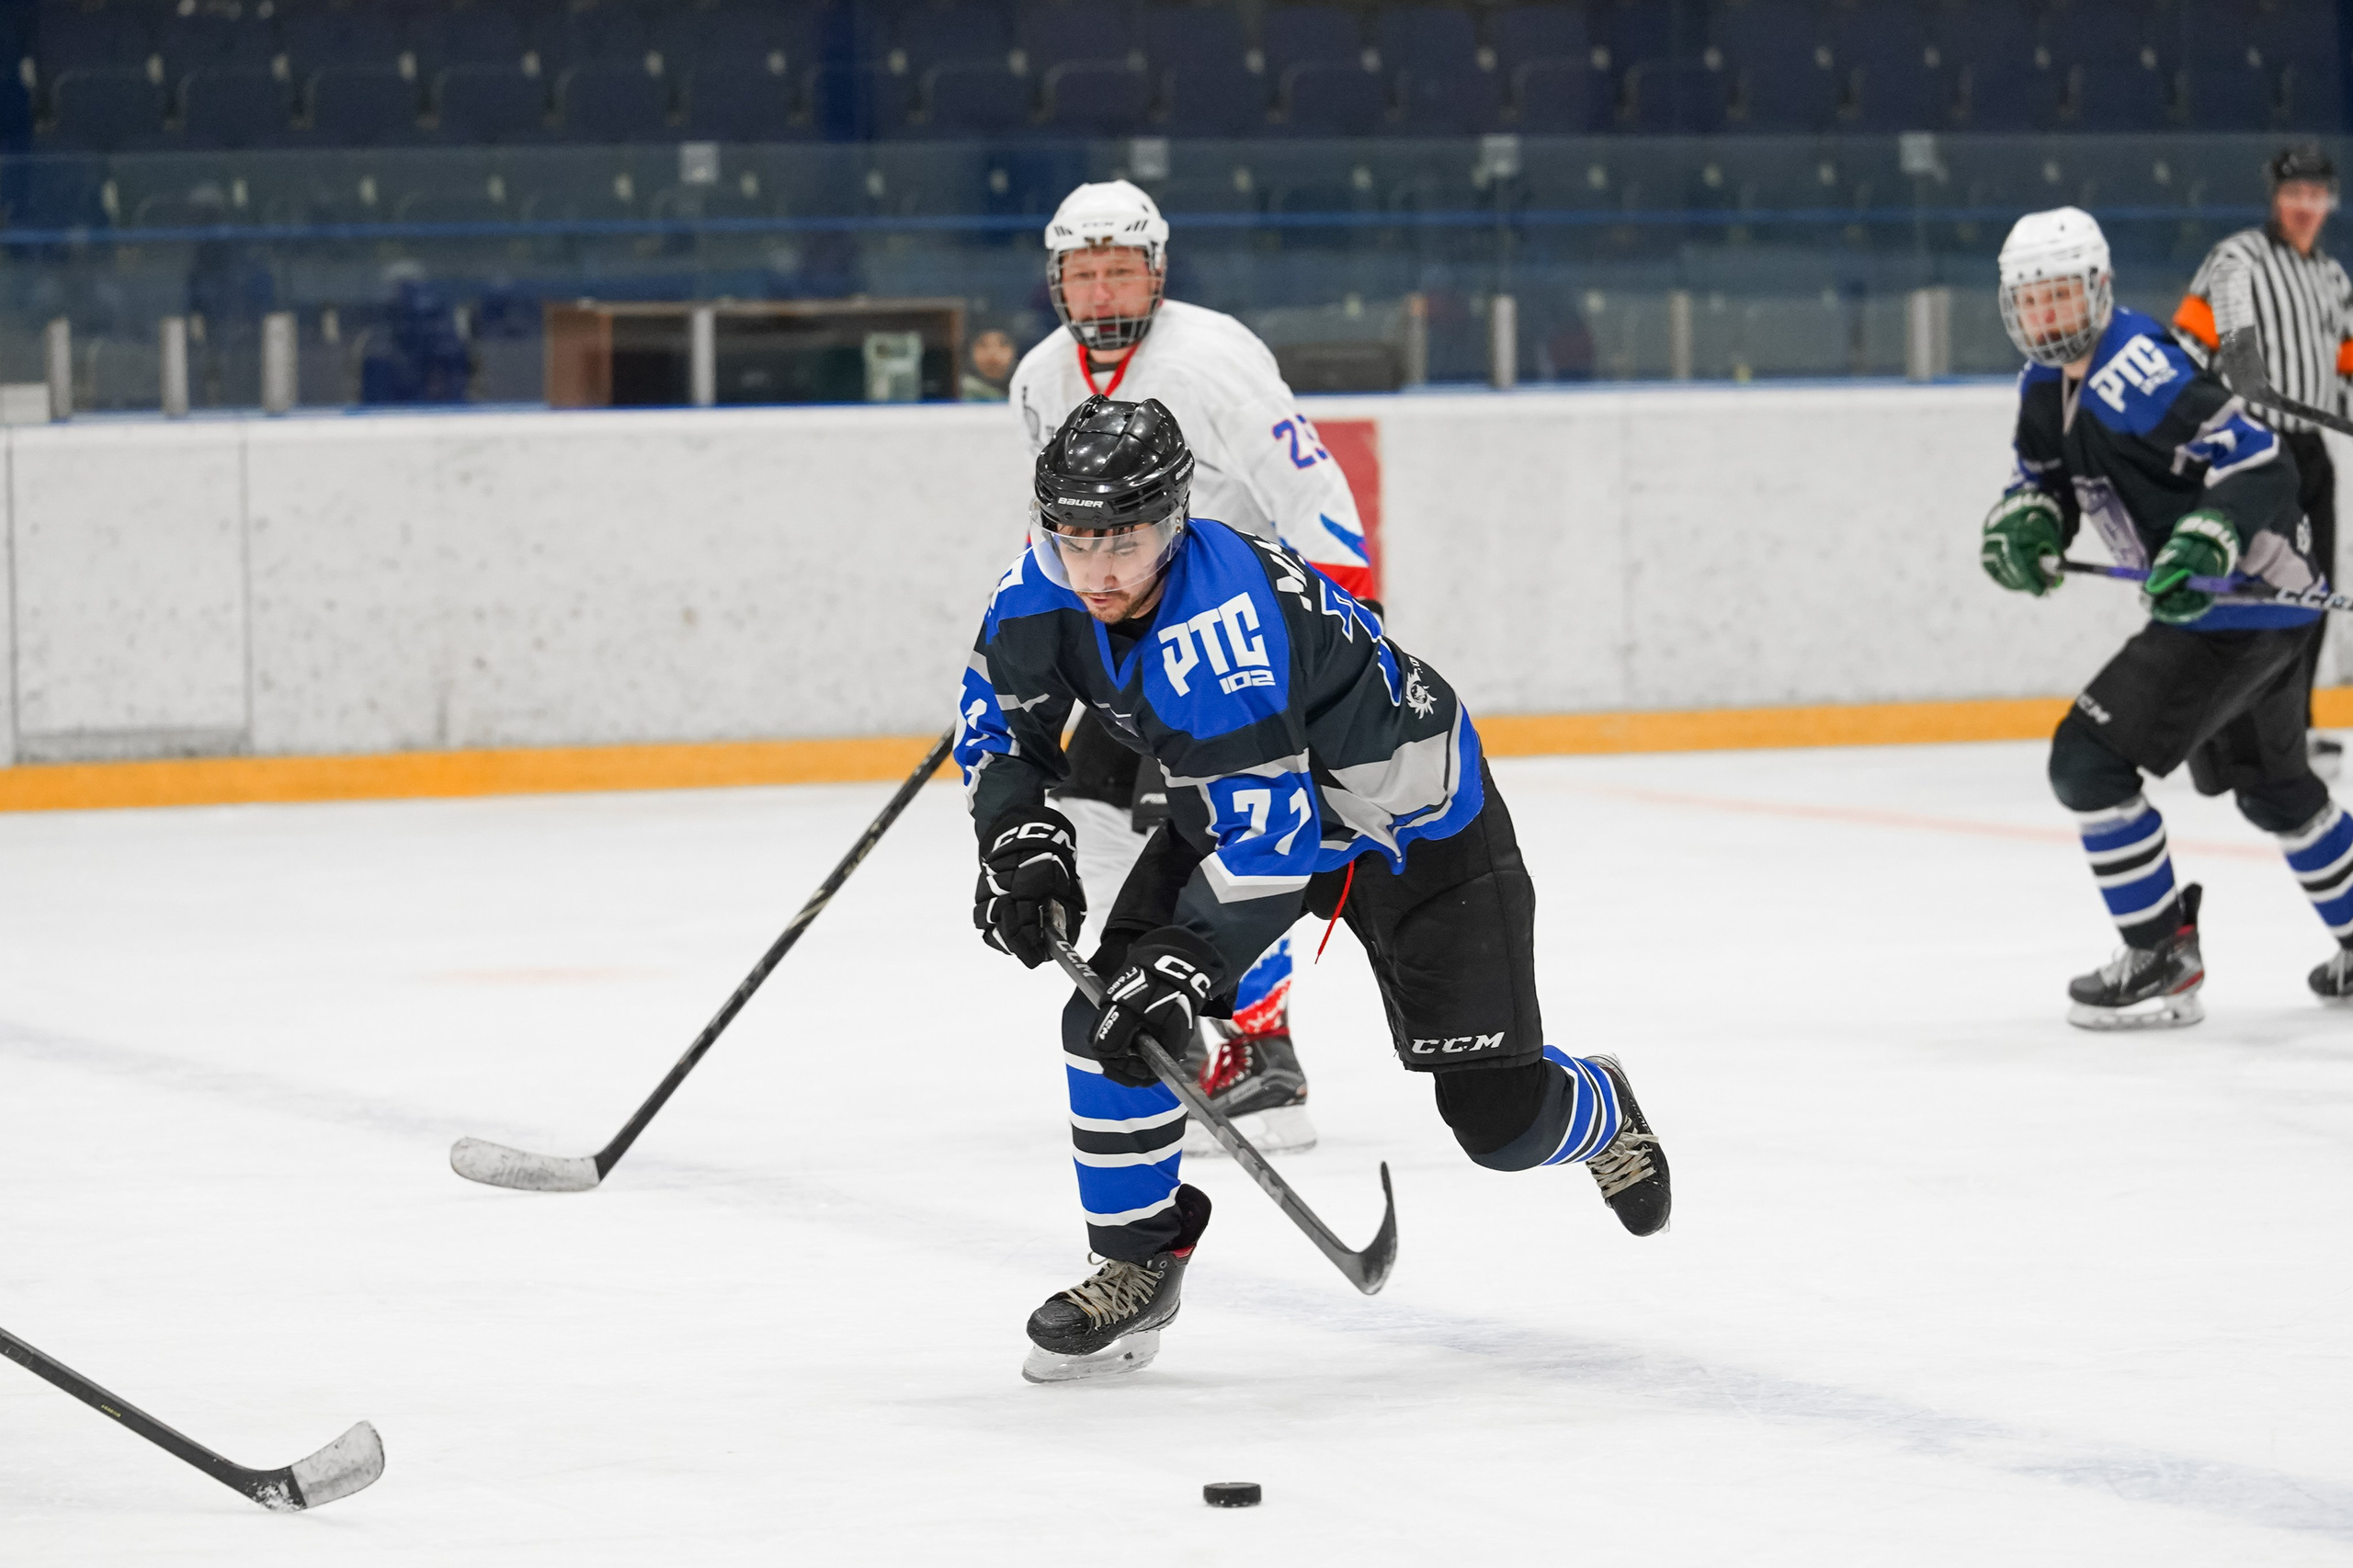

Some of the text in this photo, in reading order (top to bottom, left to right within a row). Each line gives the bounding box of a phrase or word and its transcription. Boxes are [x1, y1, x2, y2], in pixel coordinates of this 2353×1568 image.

[2087, 333, 2170, 414] PTC
[1057, 496, 1104, 508] BAUER
[1157, 591, 1270, 698] PTC
[1218, 668, 1277, 695] 102
[1232, 788, 1313, 856] 77
[1056, 939, 1098, 978] CCM
[1154, 954, 1213, 1001] CC
[1098, 1011, 1120, 1040] CCM
[1411, 1031, 1506, 1054] CCM
